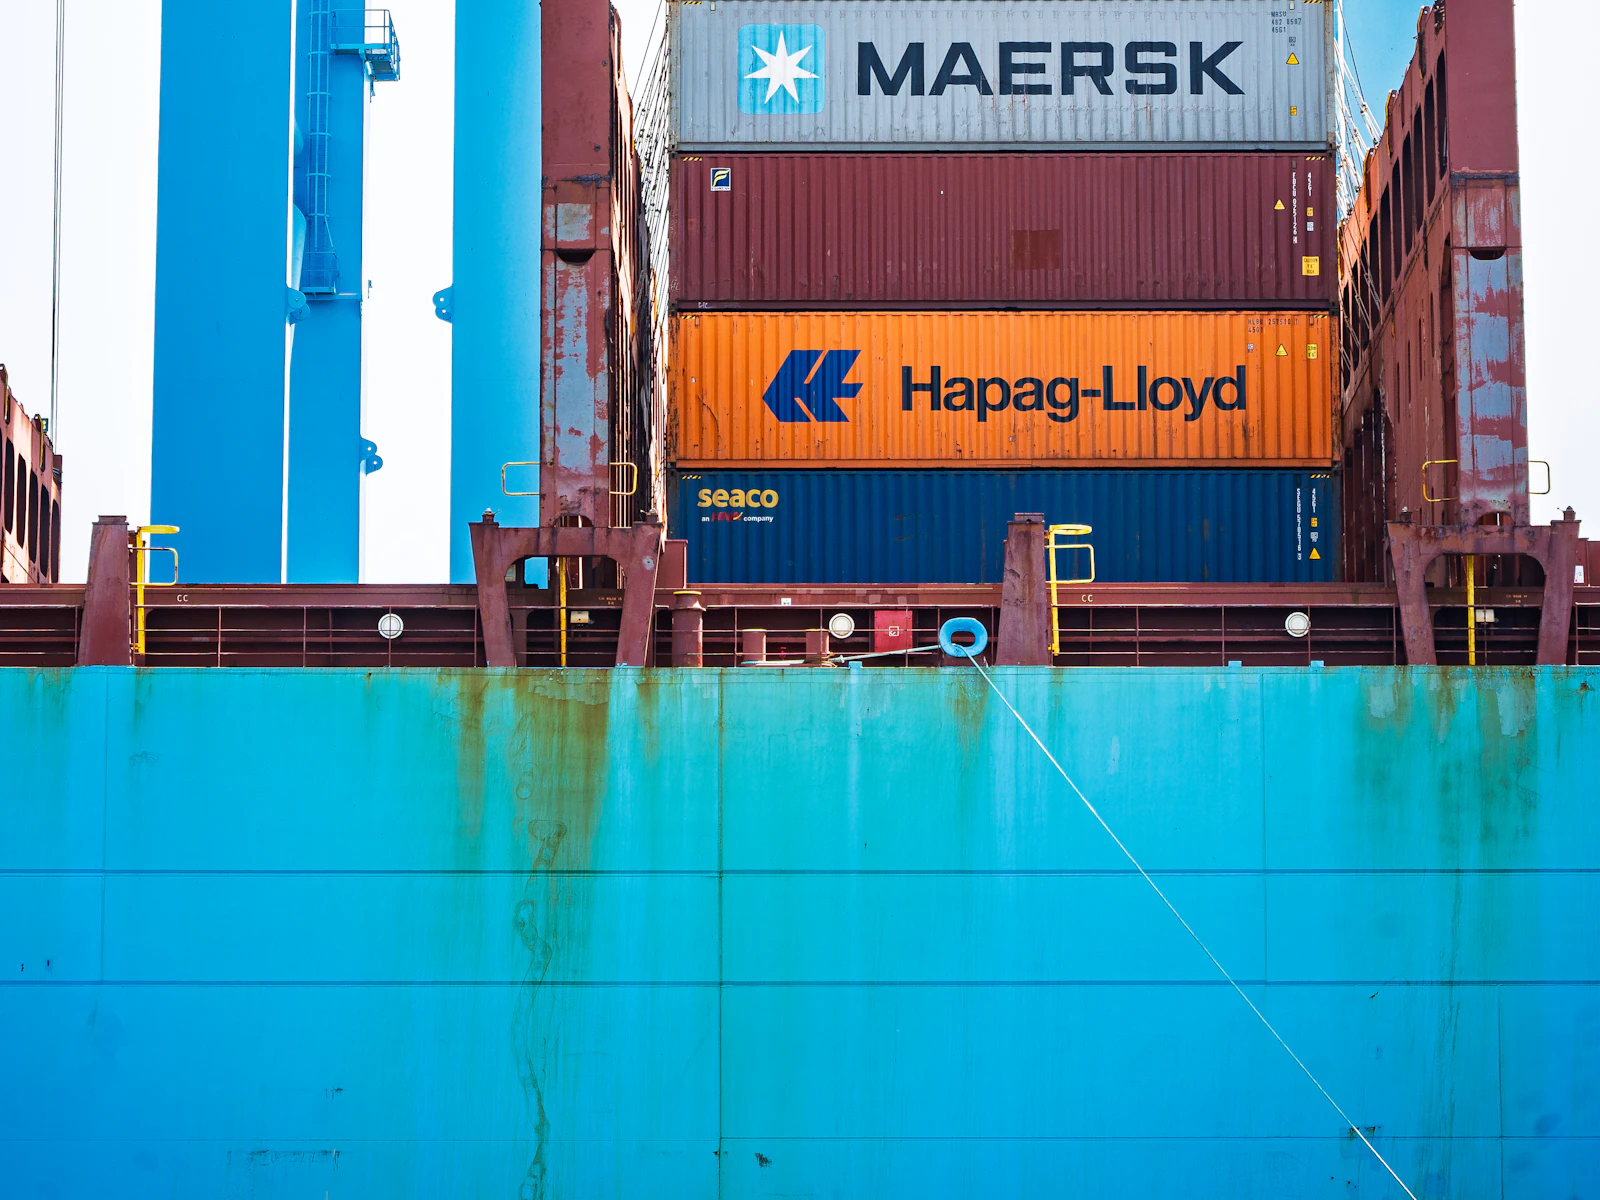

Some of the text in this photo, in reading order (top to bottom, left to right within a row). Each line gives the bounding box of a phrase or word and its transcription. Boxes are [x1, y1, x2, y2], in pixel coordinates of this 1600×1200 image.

[857, 41, 1245, 96] MAERSK
[902, 365, 1246, 422] Hapag-Lloyd
[697, 488, 779, 508] seaco
